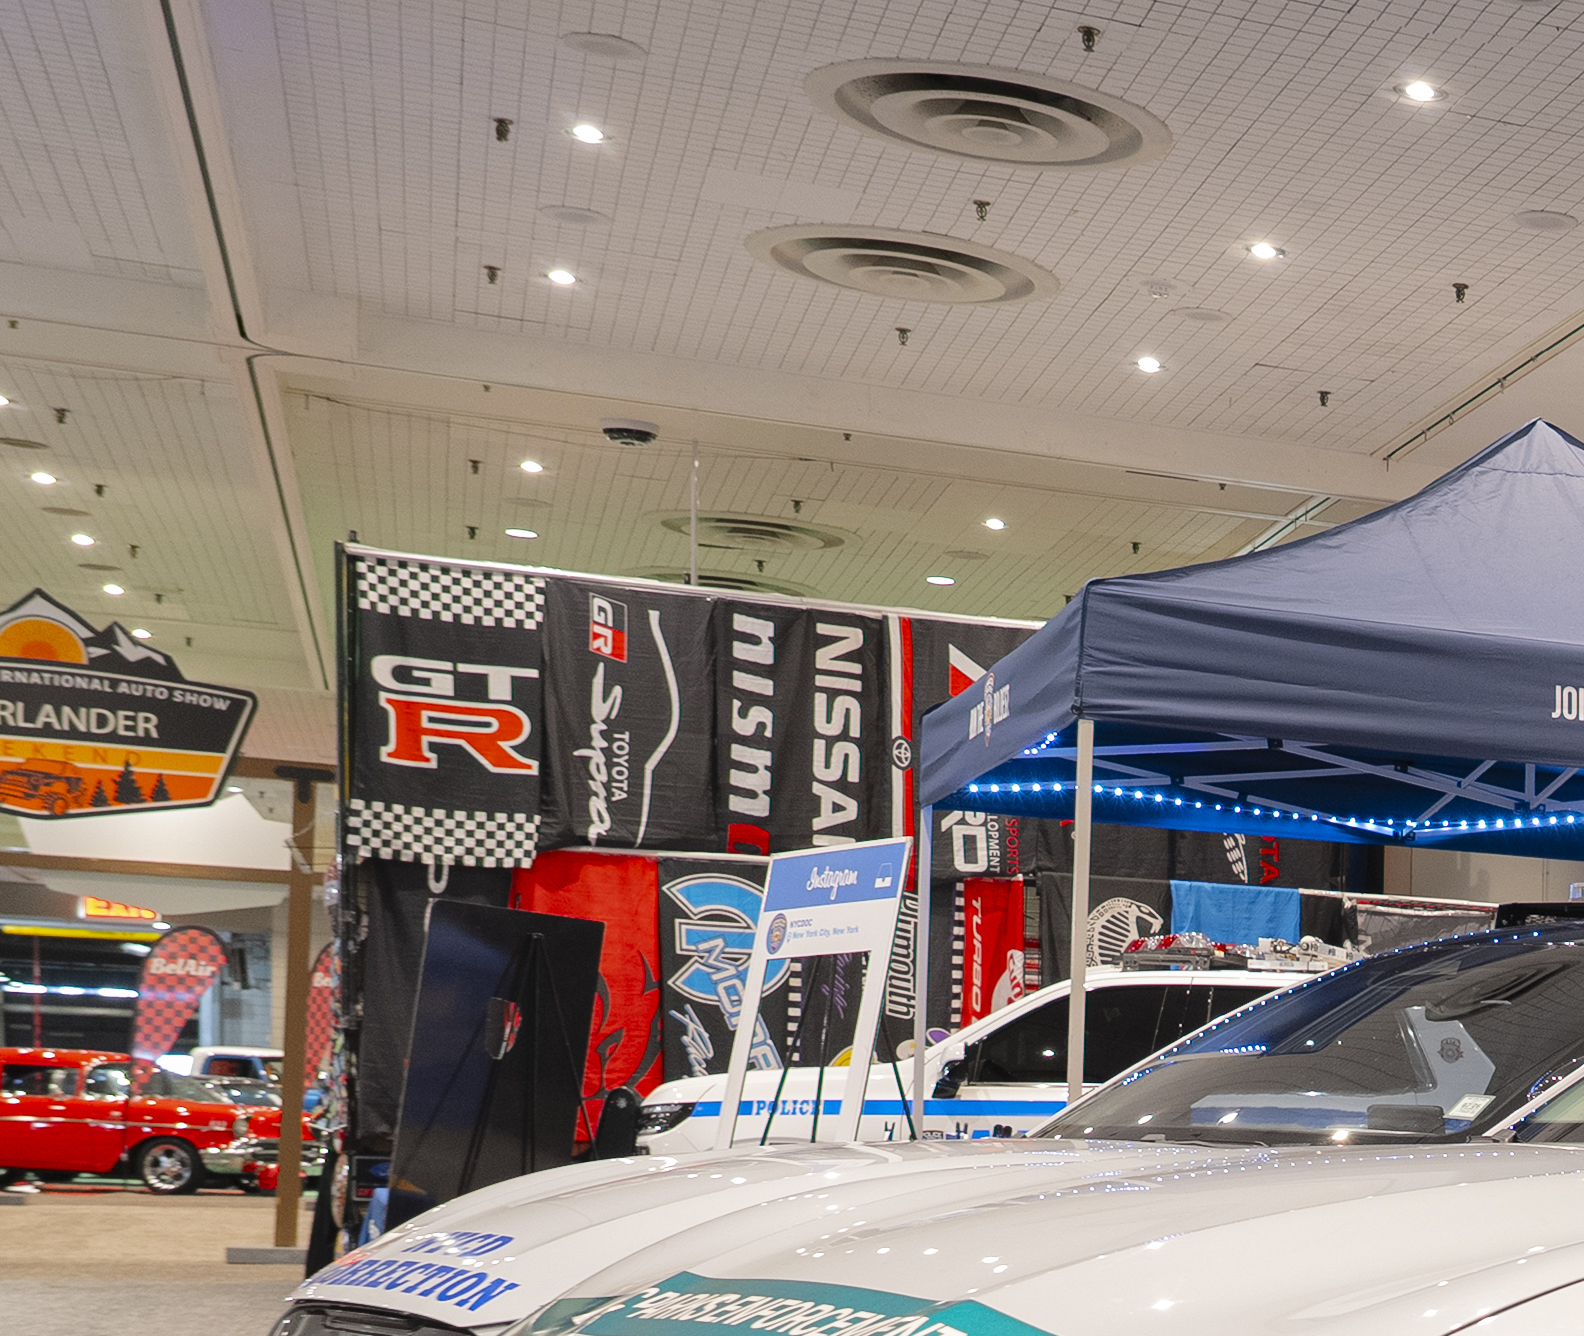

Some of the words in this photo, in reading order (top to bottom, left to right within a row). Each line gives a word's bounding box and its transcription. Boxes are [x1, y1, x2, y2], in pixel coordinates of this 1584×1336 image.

[591, 597, 613, 656] GR
[117, 682, 169, 700] AUTO
[172, 690, 231, 711] SHOW
[371, 655, 540, 701] GT
[378, 690, 540, 776] R
[573, 662, 623, 846] Supra
[811, 623, 865, 846] NISSA
[611, 731, 630, 801] TOYOTA
[806, 866, 858, 900] Instagram
[150, 958, 216, 977] BelAir
